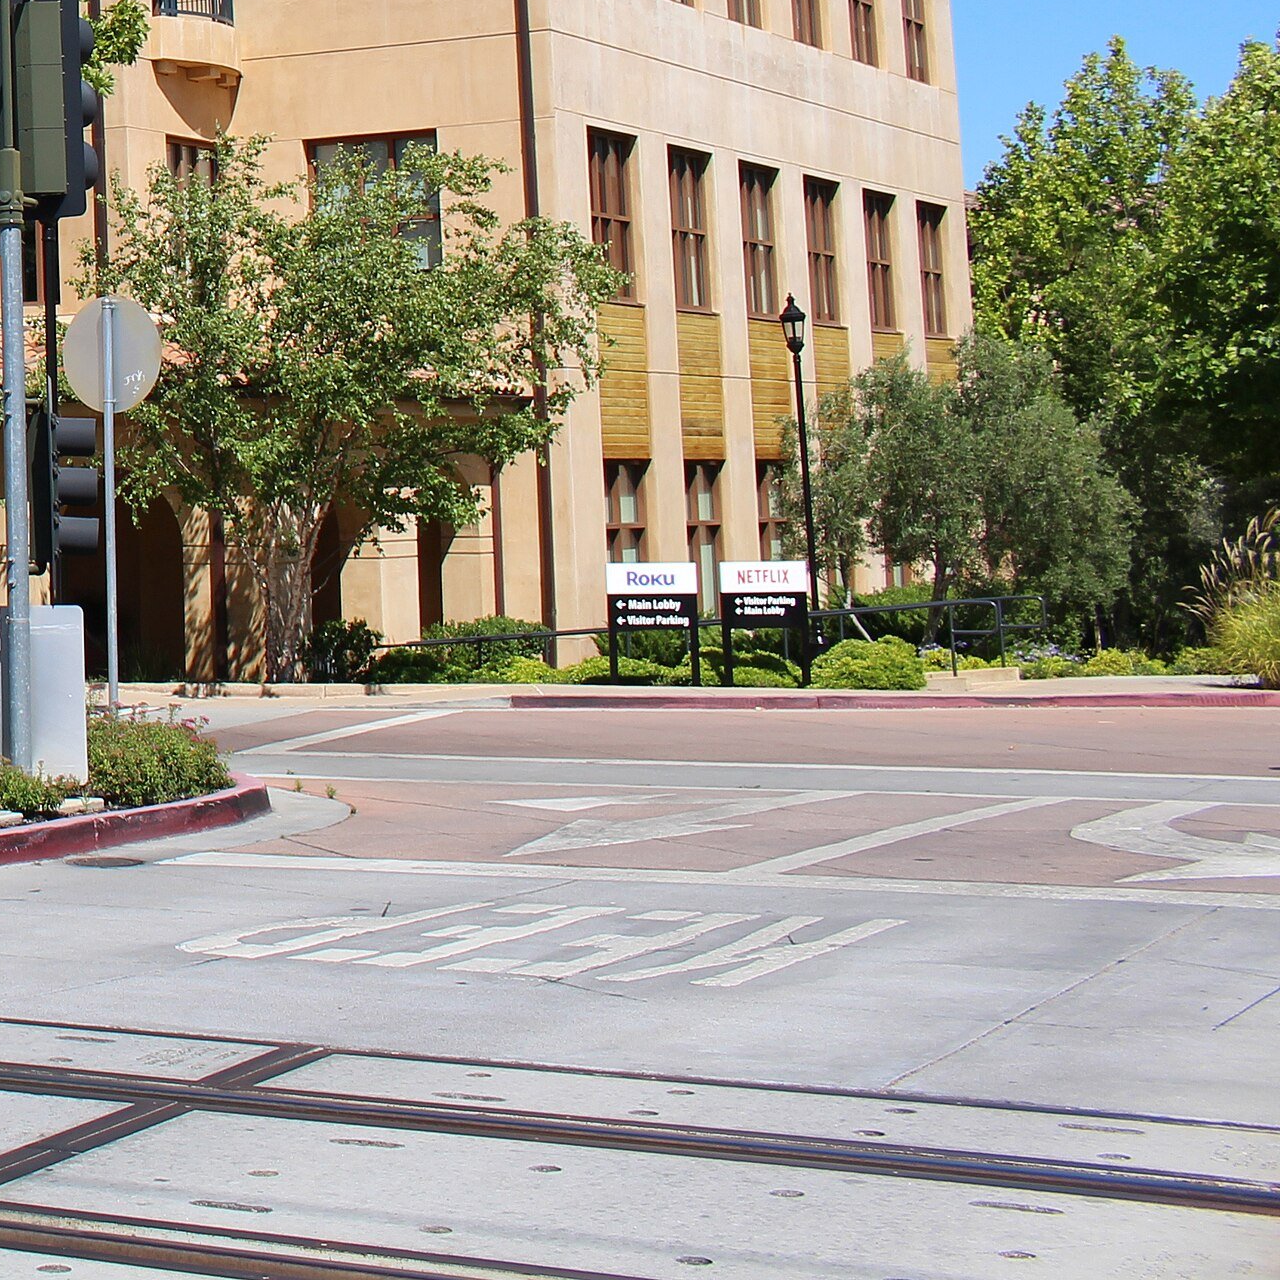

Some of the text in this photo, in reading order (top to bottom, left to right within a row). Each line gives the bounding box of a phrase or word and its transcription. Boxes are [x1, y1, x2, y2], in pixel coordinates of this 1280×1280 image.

[737, 569, 790, 585] NETFLIX
[627, 598, 681, 612] Main Lobby
[743, 596, 796, 607] Visitor Parking
[743, 606, 786, 617] Main Lobby
[626, 614, 690, 627] Visitor Parking
[173, 901, 910, 988] KEEP
